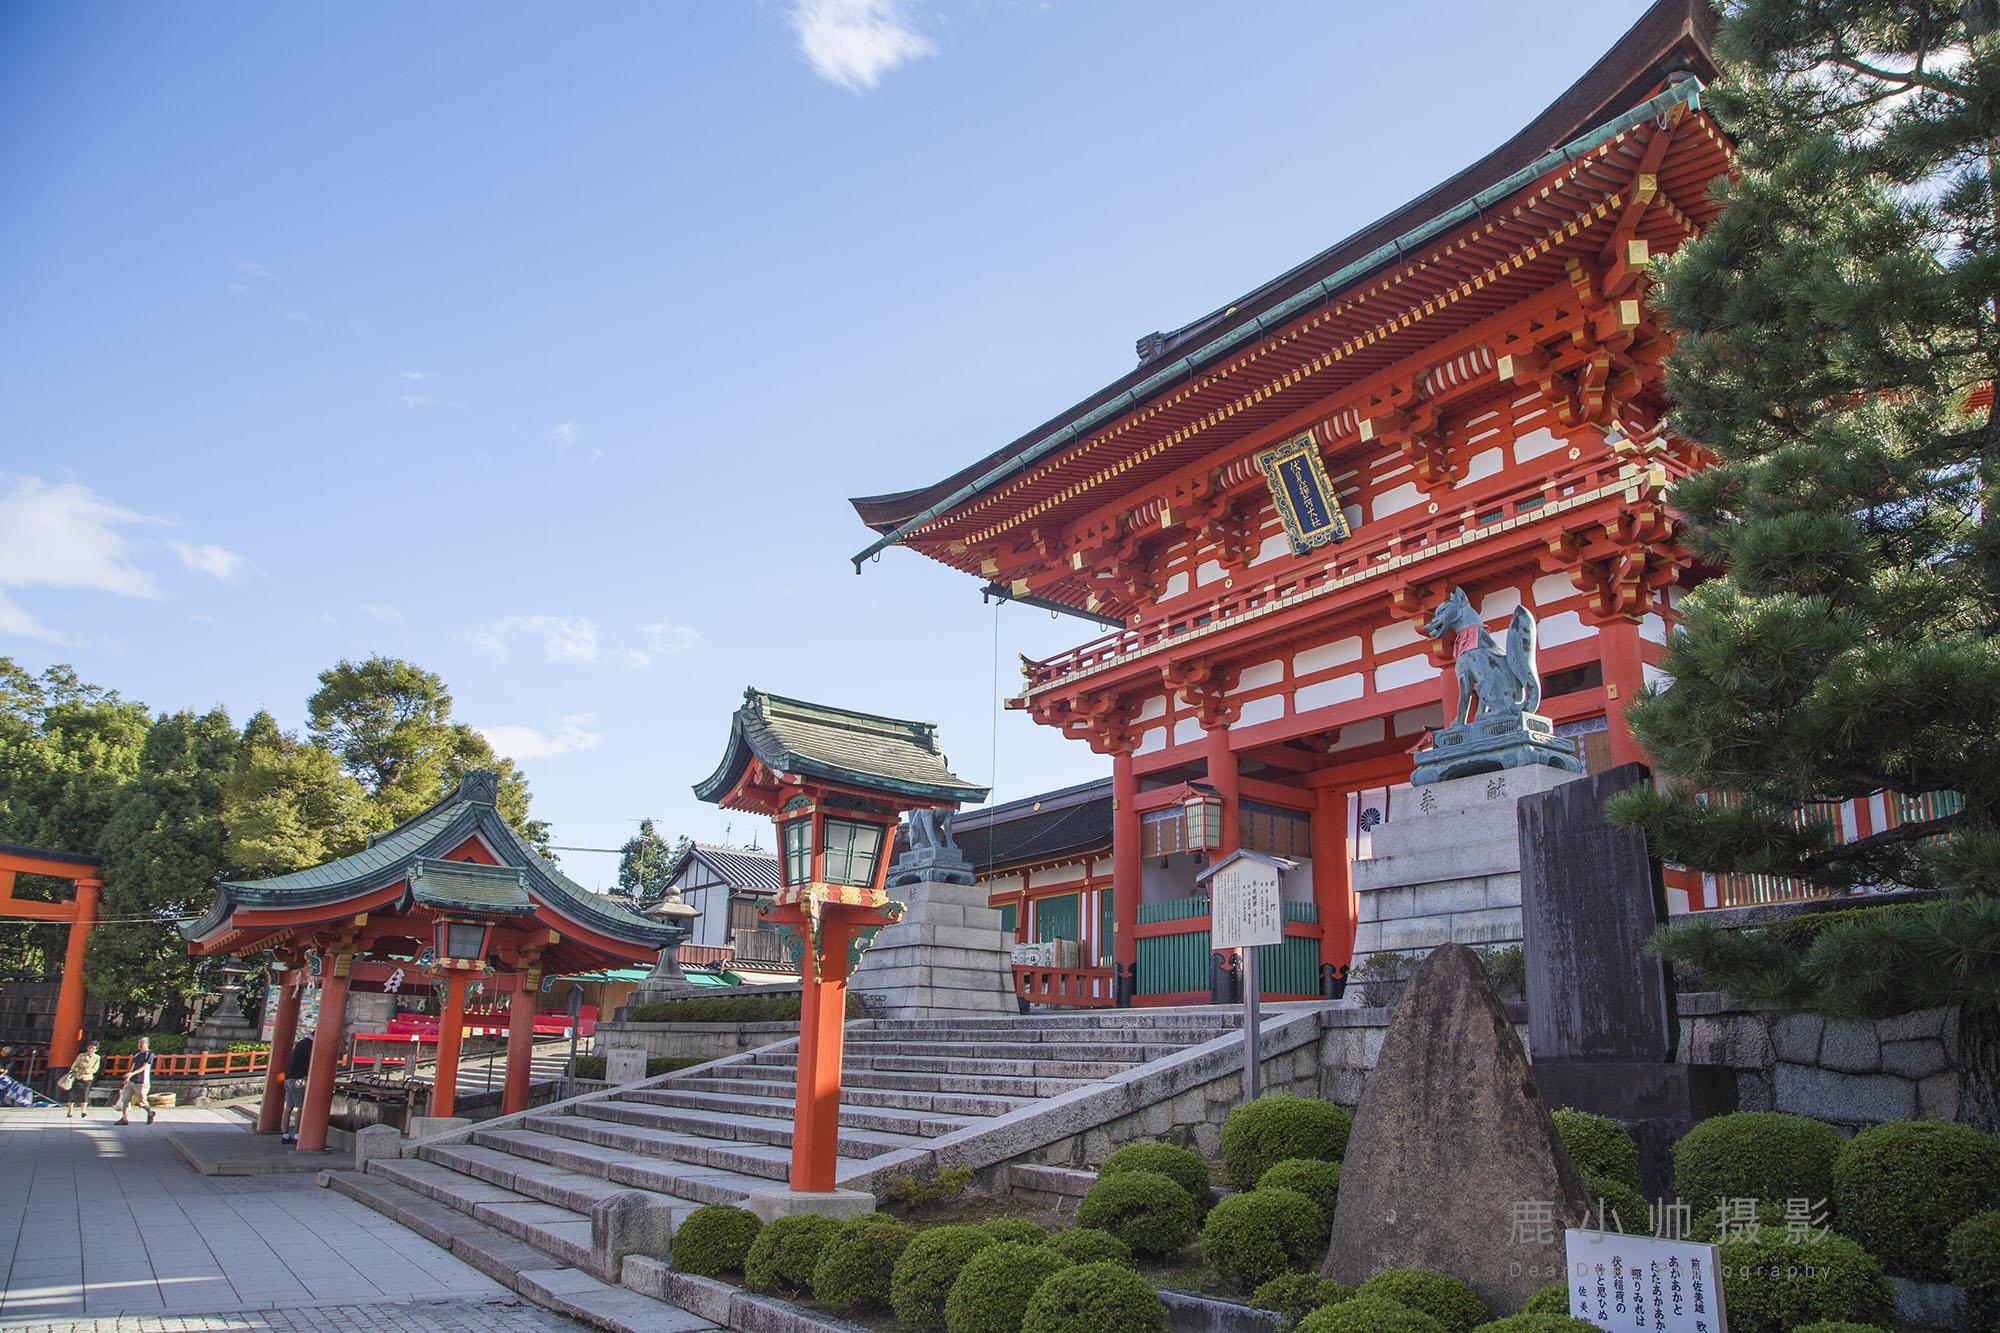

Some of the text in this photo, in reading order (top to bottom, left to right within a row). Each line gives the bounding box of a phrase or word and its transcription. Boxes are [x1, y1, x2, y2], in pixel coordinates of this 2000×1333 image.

[1611, 1255, 1627, 1314] 伏見稲荷の
[1650, 1260, 1667, 1333] たたあかあか
[1668, 1255, 1684, 1316] あかあかと
